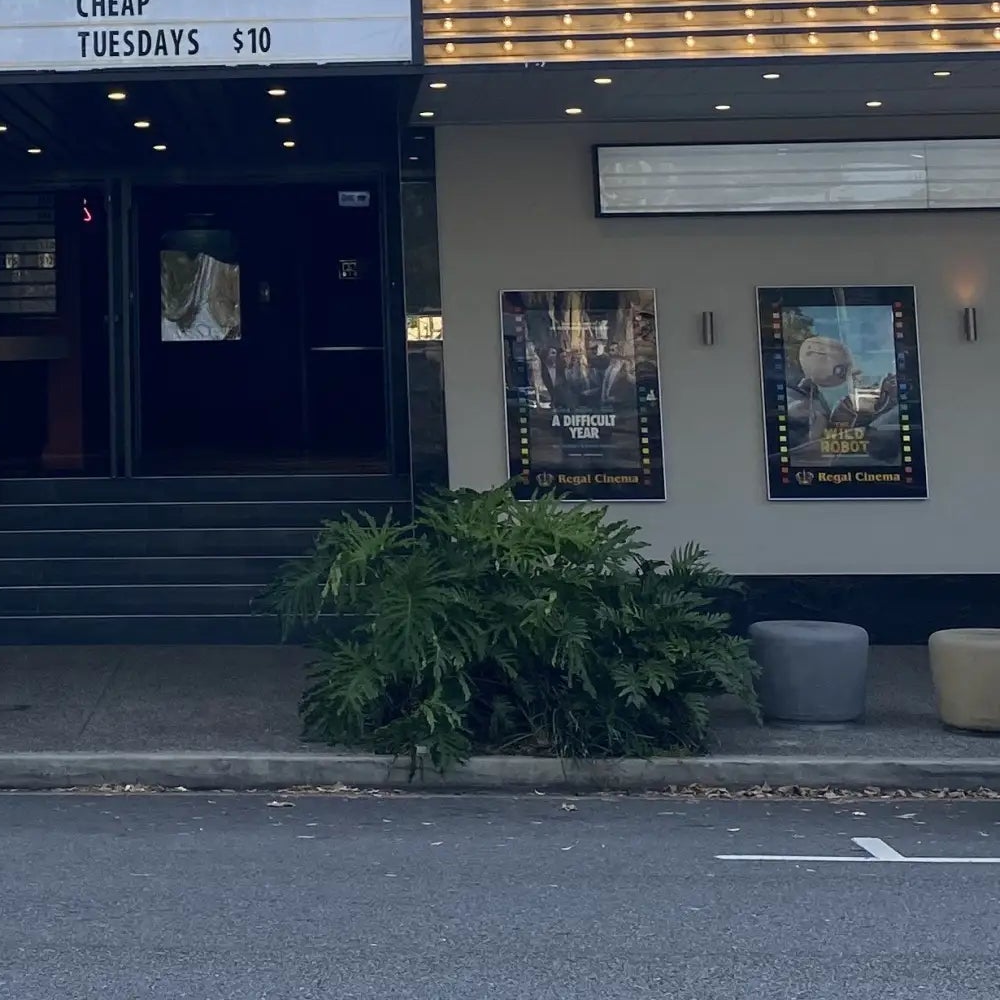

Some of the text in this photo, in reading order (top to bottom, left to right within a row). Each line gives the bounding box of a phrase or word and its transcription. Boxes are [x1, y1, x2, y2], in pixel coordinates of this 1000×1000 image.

[77, 27, 271, 58] TUESDAYS $10
[551, 414, 617, 427] A DIFFICULT
[568, 426, 600, 439] YEAR
[823, 427, 866, 440] WILD
[820, 440, 870, 453] ROBOT
[558, 473, 639, 485] Regal Cinema
[818, 471, 901, 484] Regal Cinema
